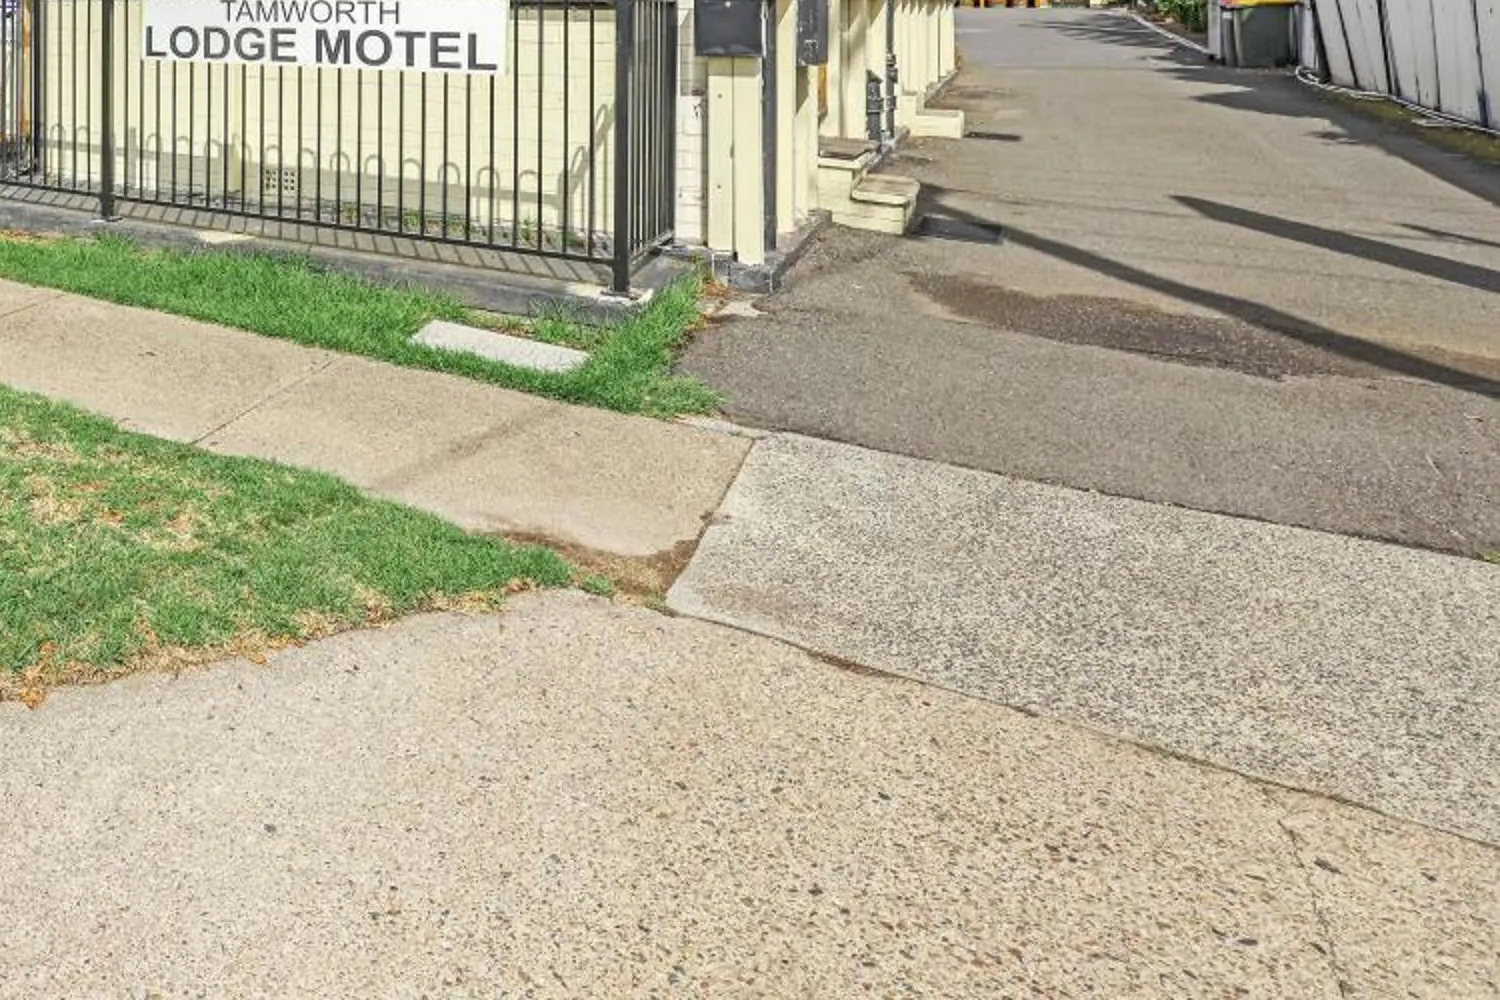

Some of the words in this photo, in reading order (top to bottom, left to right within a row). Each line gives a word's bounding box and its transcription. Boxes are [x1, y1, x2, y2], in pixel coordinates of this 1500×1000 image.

[220, 0, 401, 25] TAMWORTH
[145, 24, 298, 63] LODGE
[314, 28, 498, 71] MOTEL
